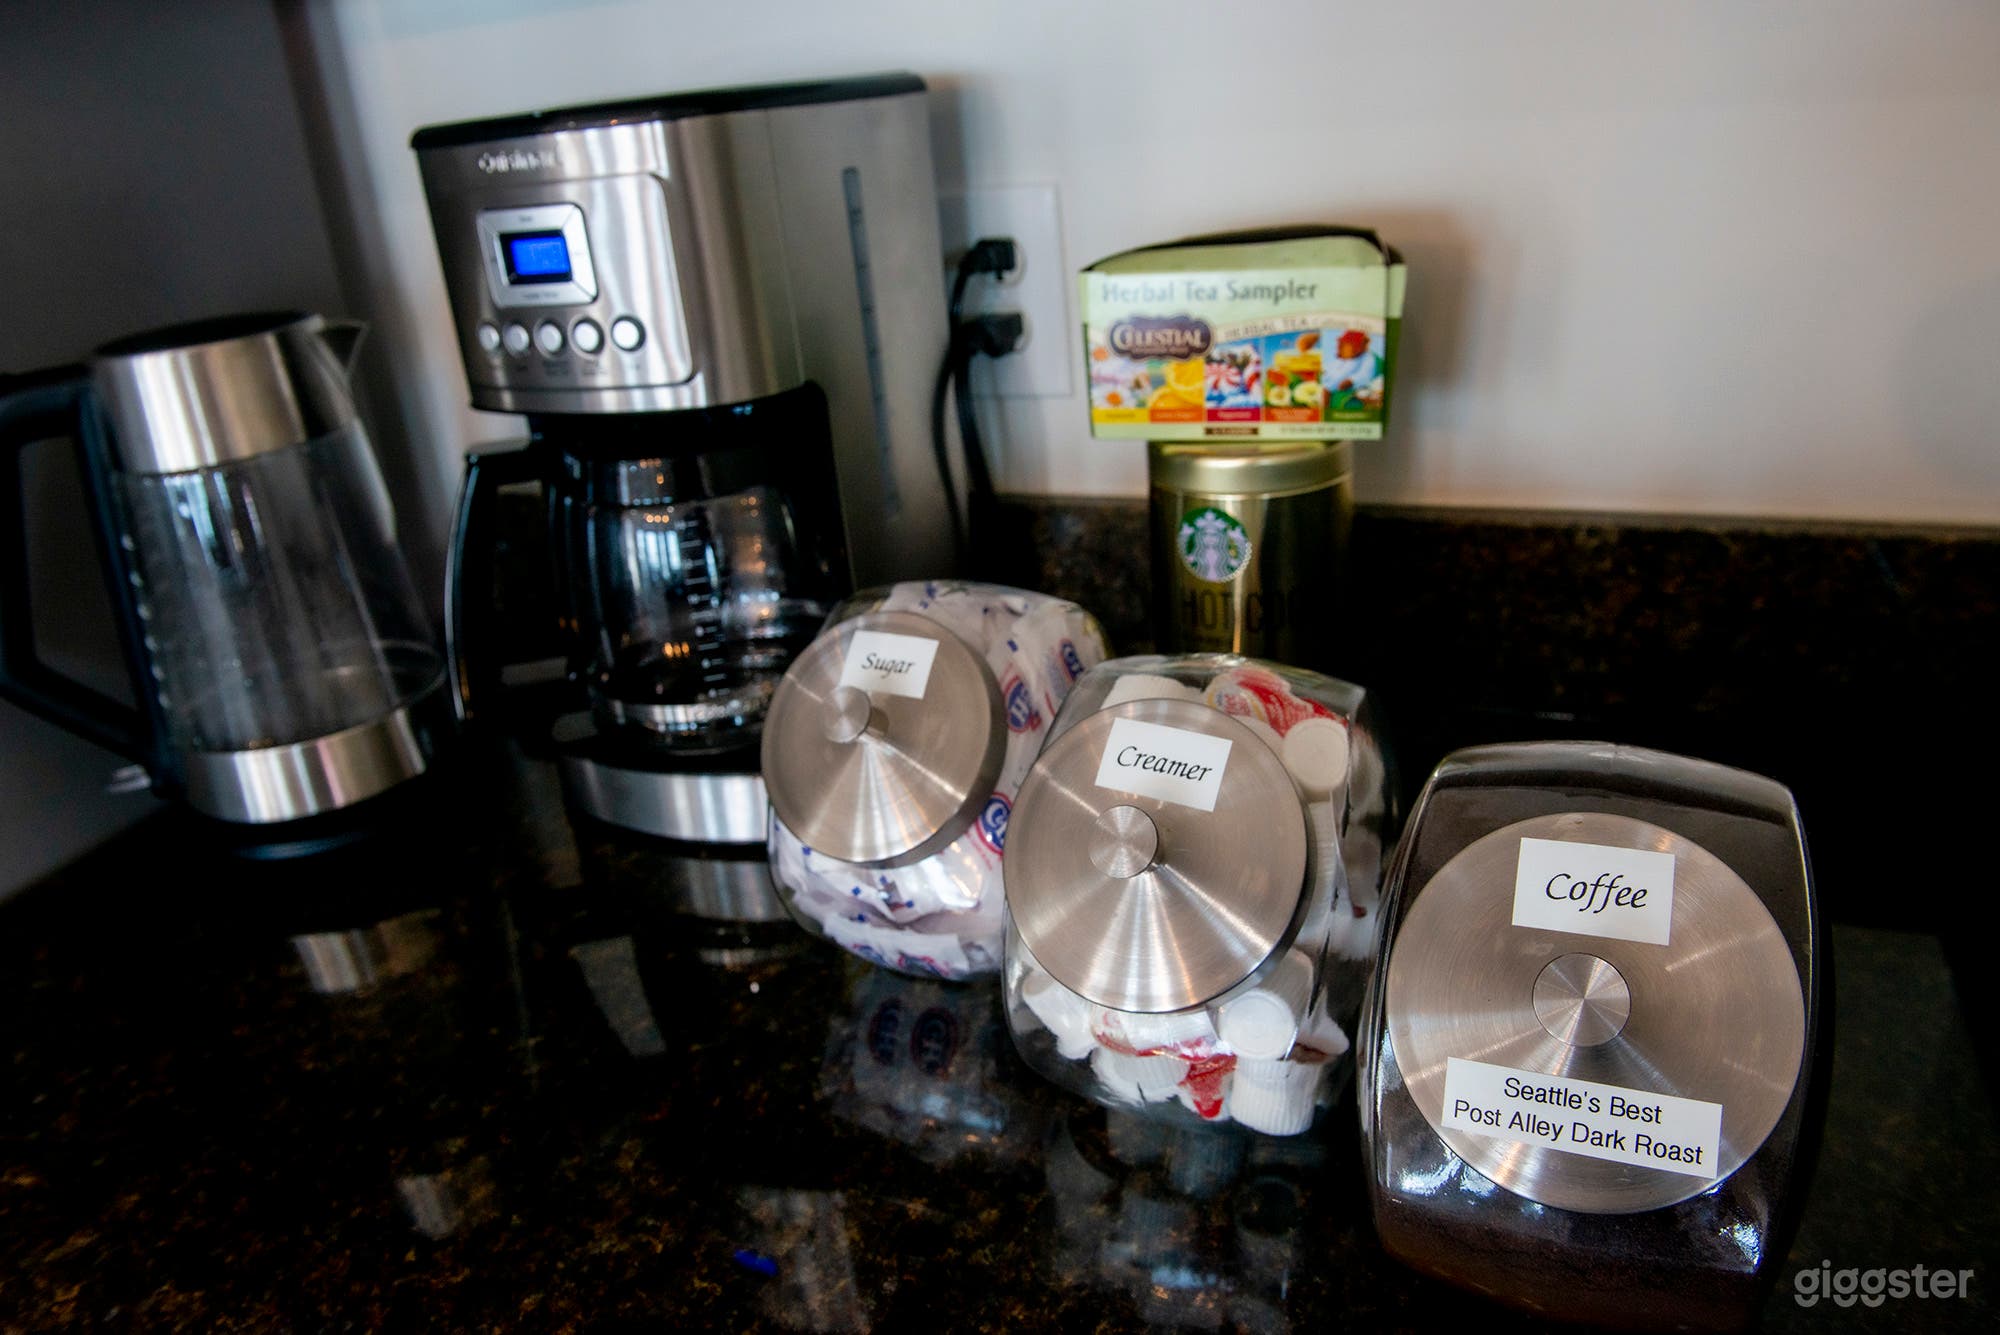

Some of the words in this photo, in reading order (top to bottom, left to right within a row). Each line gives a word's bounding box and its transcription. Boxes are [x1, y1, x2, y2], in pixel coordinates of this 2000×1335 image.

[1102, 281, 1174, 303] Herbal
[1186, 281, 1217, 301] Tea
[1227, 279, 1317, 304] Sampler
[861, 652, 915, 679] Sugar
[1117, 745, 1212, 782] Creamer
[1545, 872, 1648, 914] Coffee
[1503, 1077, 1601, 1114] Seattle's
[1609, 1095, 1662, 1124] Best
[1453, 1099, 1501, 1128] Post
[1507, 1110, 1564, 1142] Alley
[1571, 1121, 1627, 1151] Dark
[1634, 1133, 1704, 1165] Roast
